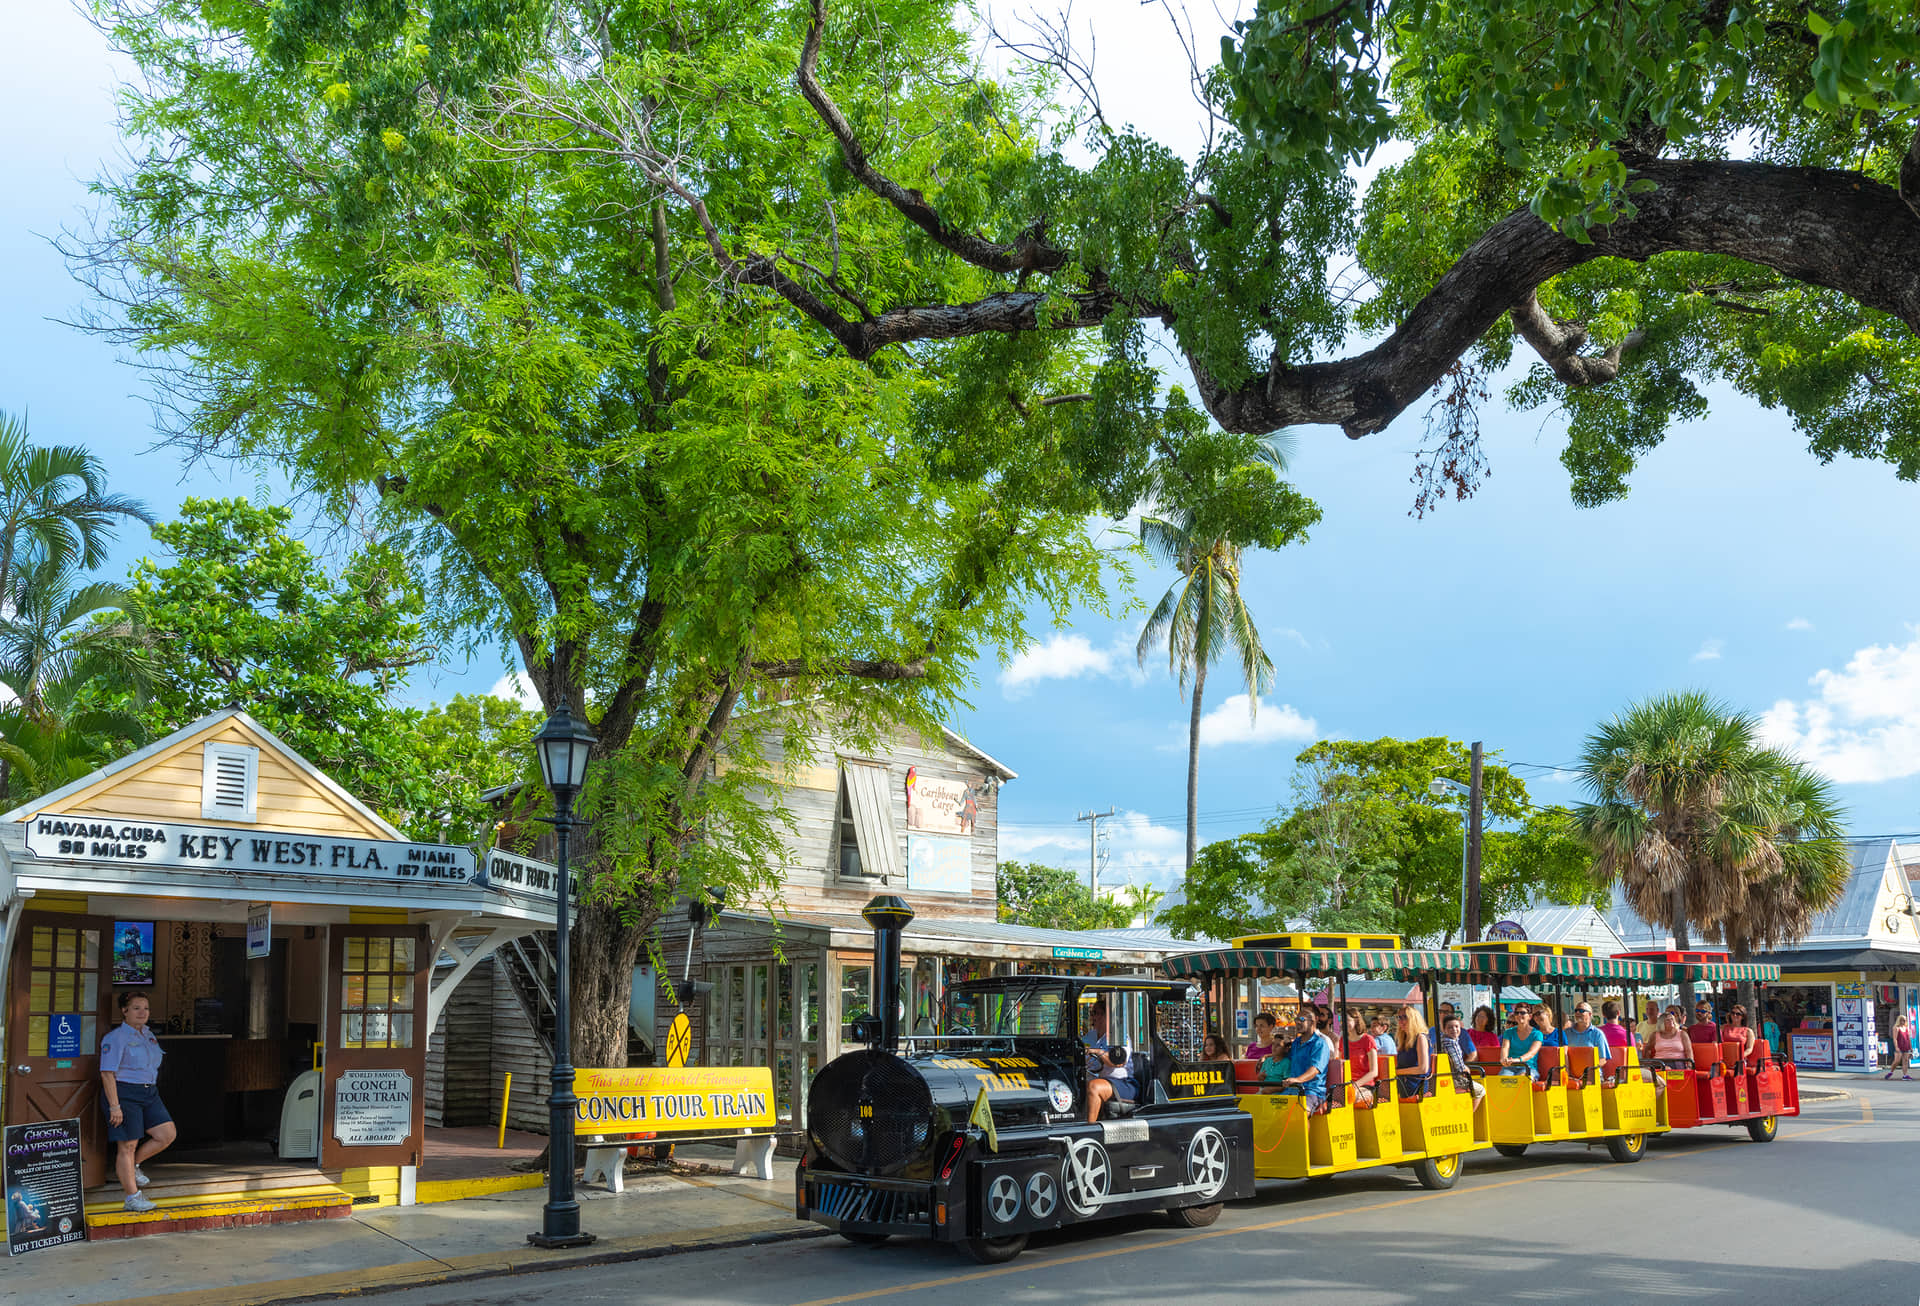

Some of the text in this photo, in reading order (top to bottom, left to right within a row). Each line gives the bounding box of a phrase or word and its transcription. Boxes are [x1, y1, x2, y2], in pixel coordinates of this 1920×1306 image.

[920, 786, 959, 802] Caribbean
[58, 839, 148, 859] 90 MILES
[179, 833, 242, 861] KEY
[331, 845, 388, 870] FLA.
[408, 849, 456, 864] MIAMI
[396, 863, 466, 880] 157 MILES
[491, 858, 578, 896] CONCH TOUR TIN
[1055, 948, 1084, 957] Caribbean
[668, 1033, 689, 1053] R R
[931, 1057, 1040, 1069] CONCH TOUR
[351, 1080, 397, 1091] CONCH
[588, 1072, 751, 1088] This is it! World Famous
[975, 1072, 1031, 1093] TRAIN
[1171, 1070, 1225, 1086] OVERSEAS R.R.
[338, 1091, 409, 1102] TOUR TRAIN
[575, 1092, 767, 1122] CONCH TOUR TRAIN
[860, 1105, 873, 1118] 108
[24, 1127, 62, 1142] GHOSTS
[1430, 1124, 1458, 1137] OVERSEAS
[8, 1137, 79, 1156] GRAVESTONES
[13, 1230, 84, 1253] BUY TICKETS HERE
